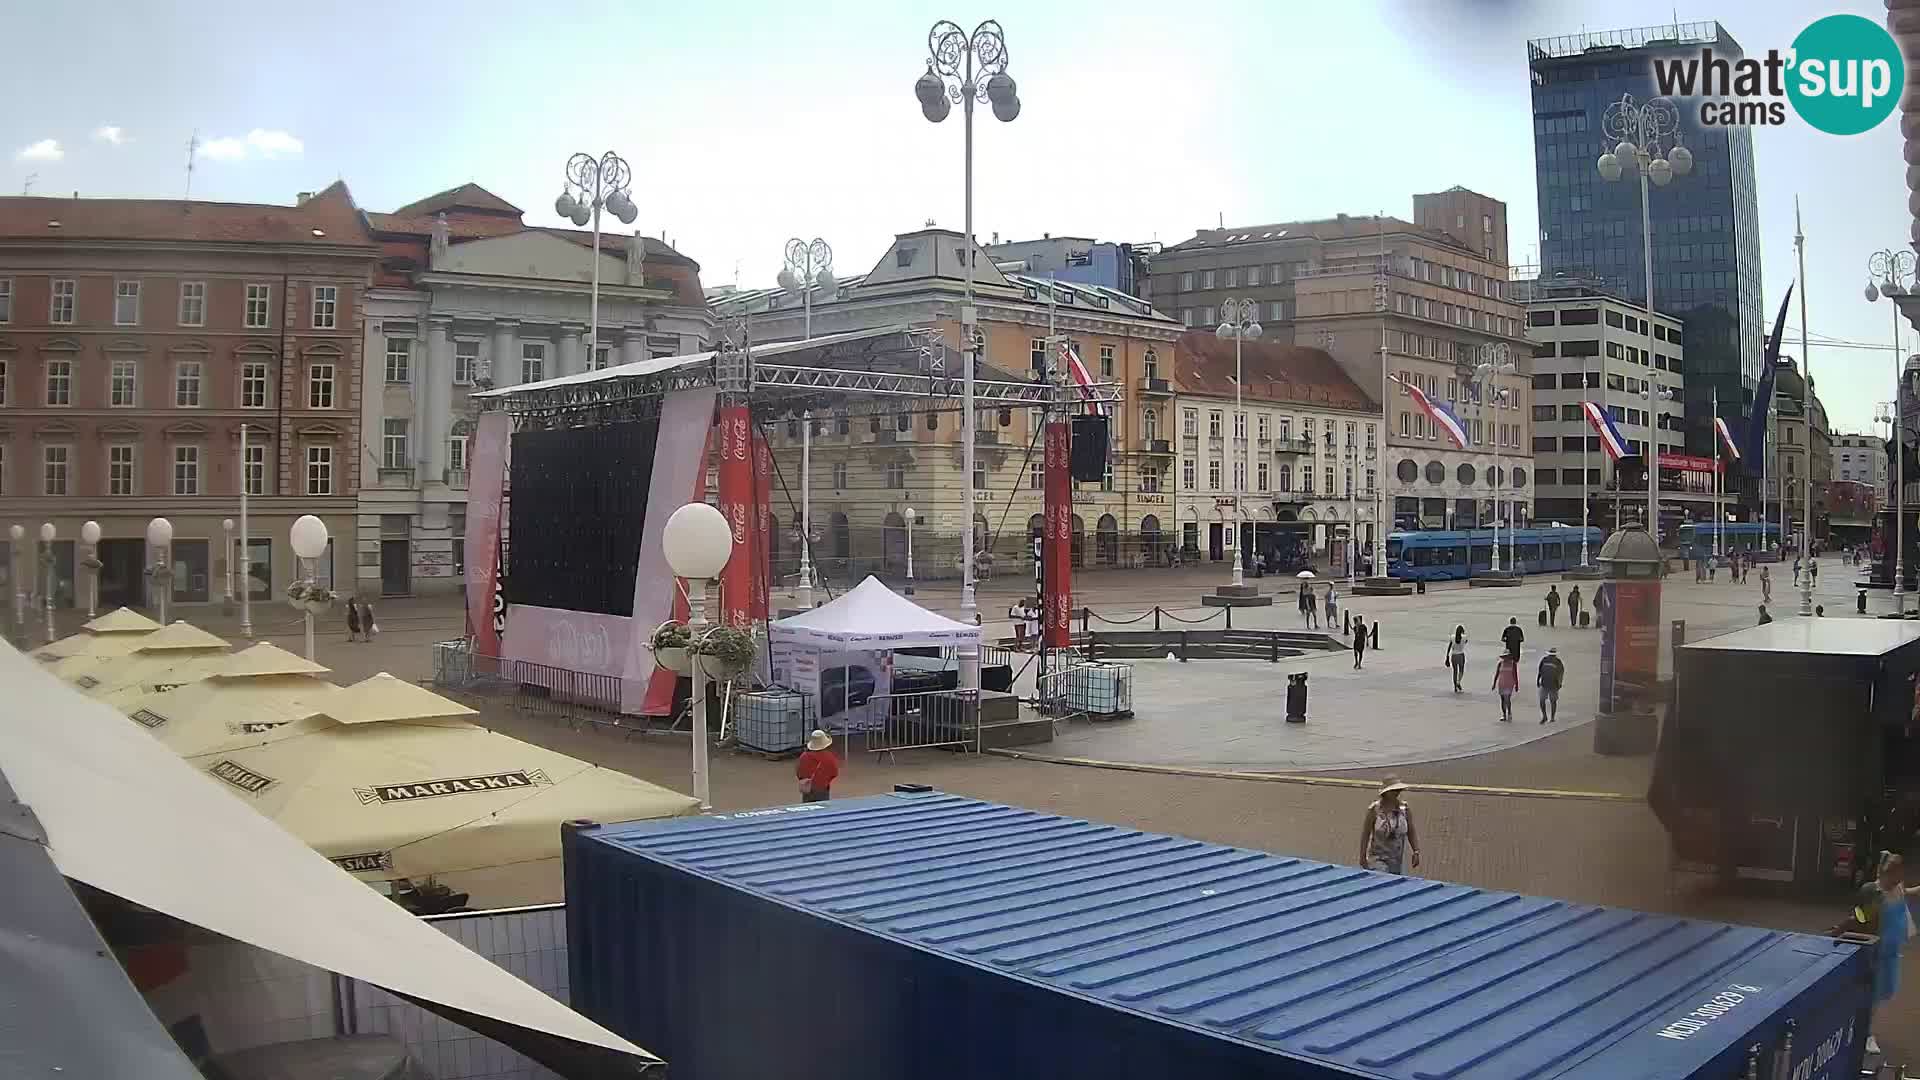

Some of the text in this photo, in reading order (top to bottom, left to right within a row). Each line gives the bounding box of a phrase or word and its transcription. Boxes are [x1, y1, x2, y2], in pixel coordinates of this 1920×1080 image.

[1136, 494, 1165, 503] SINGER
[385, 772, 526, 801] MARASKA
[1689, 991, 1745, 1020] 300629
